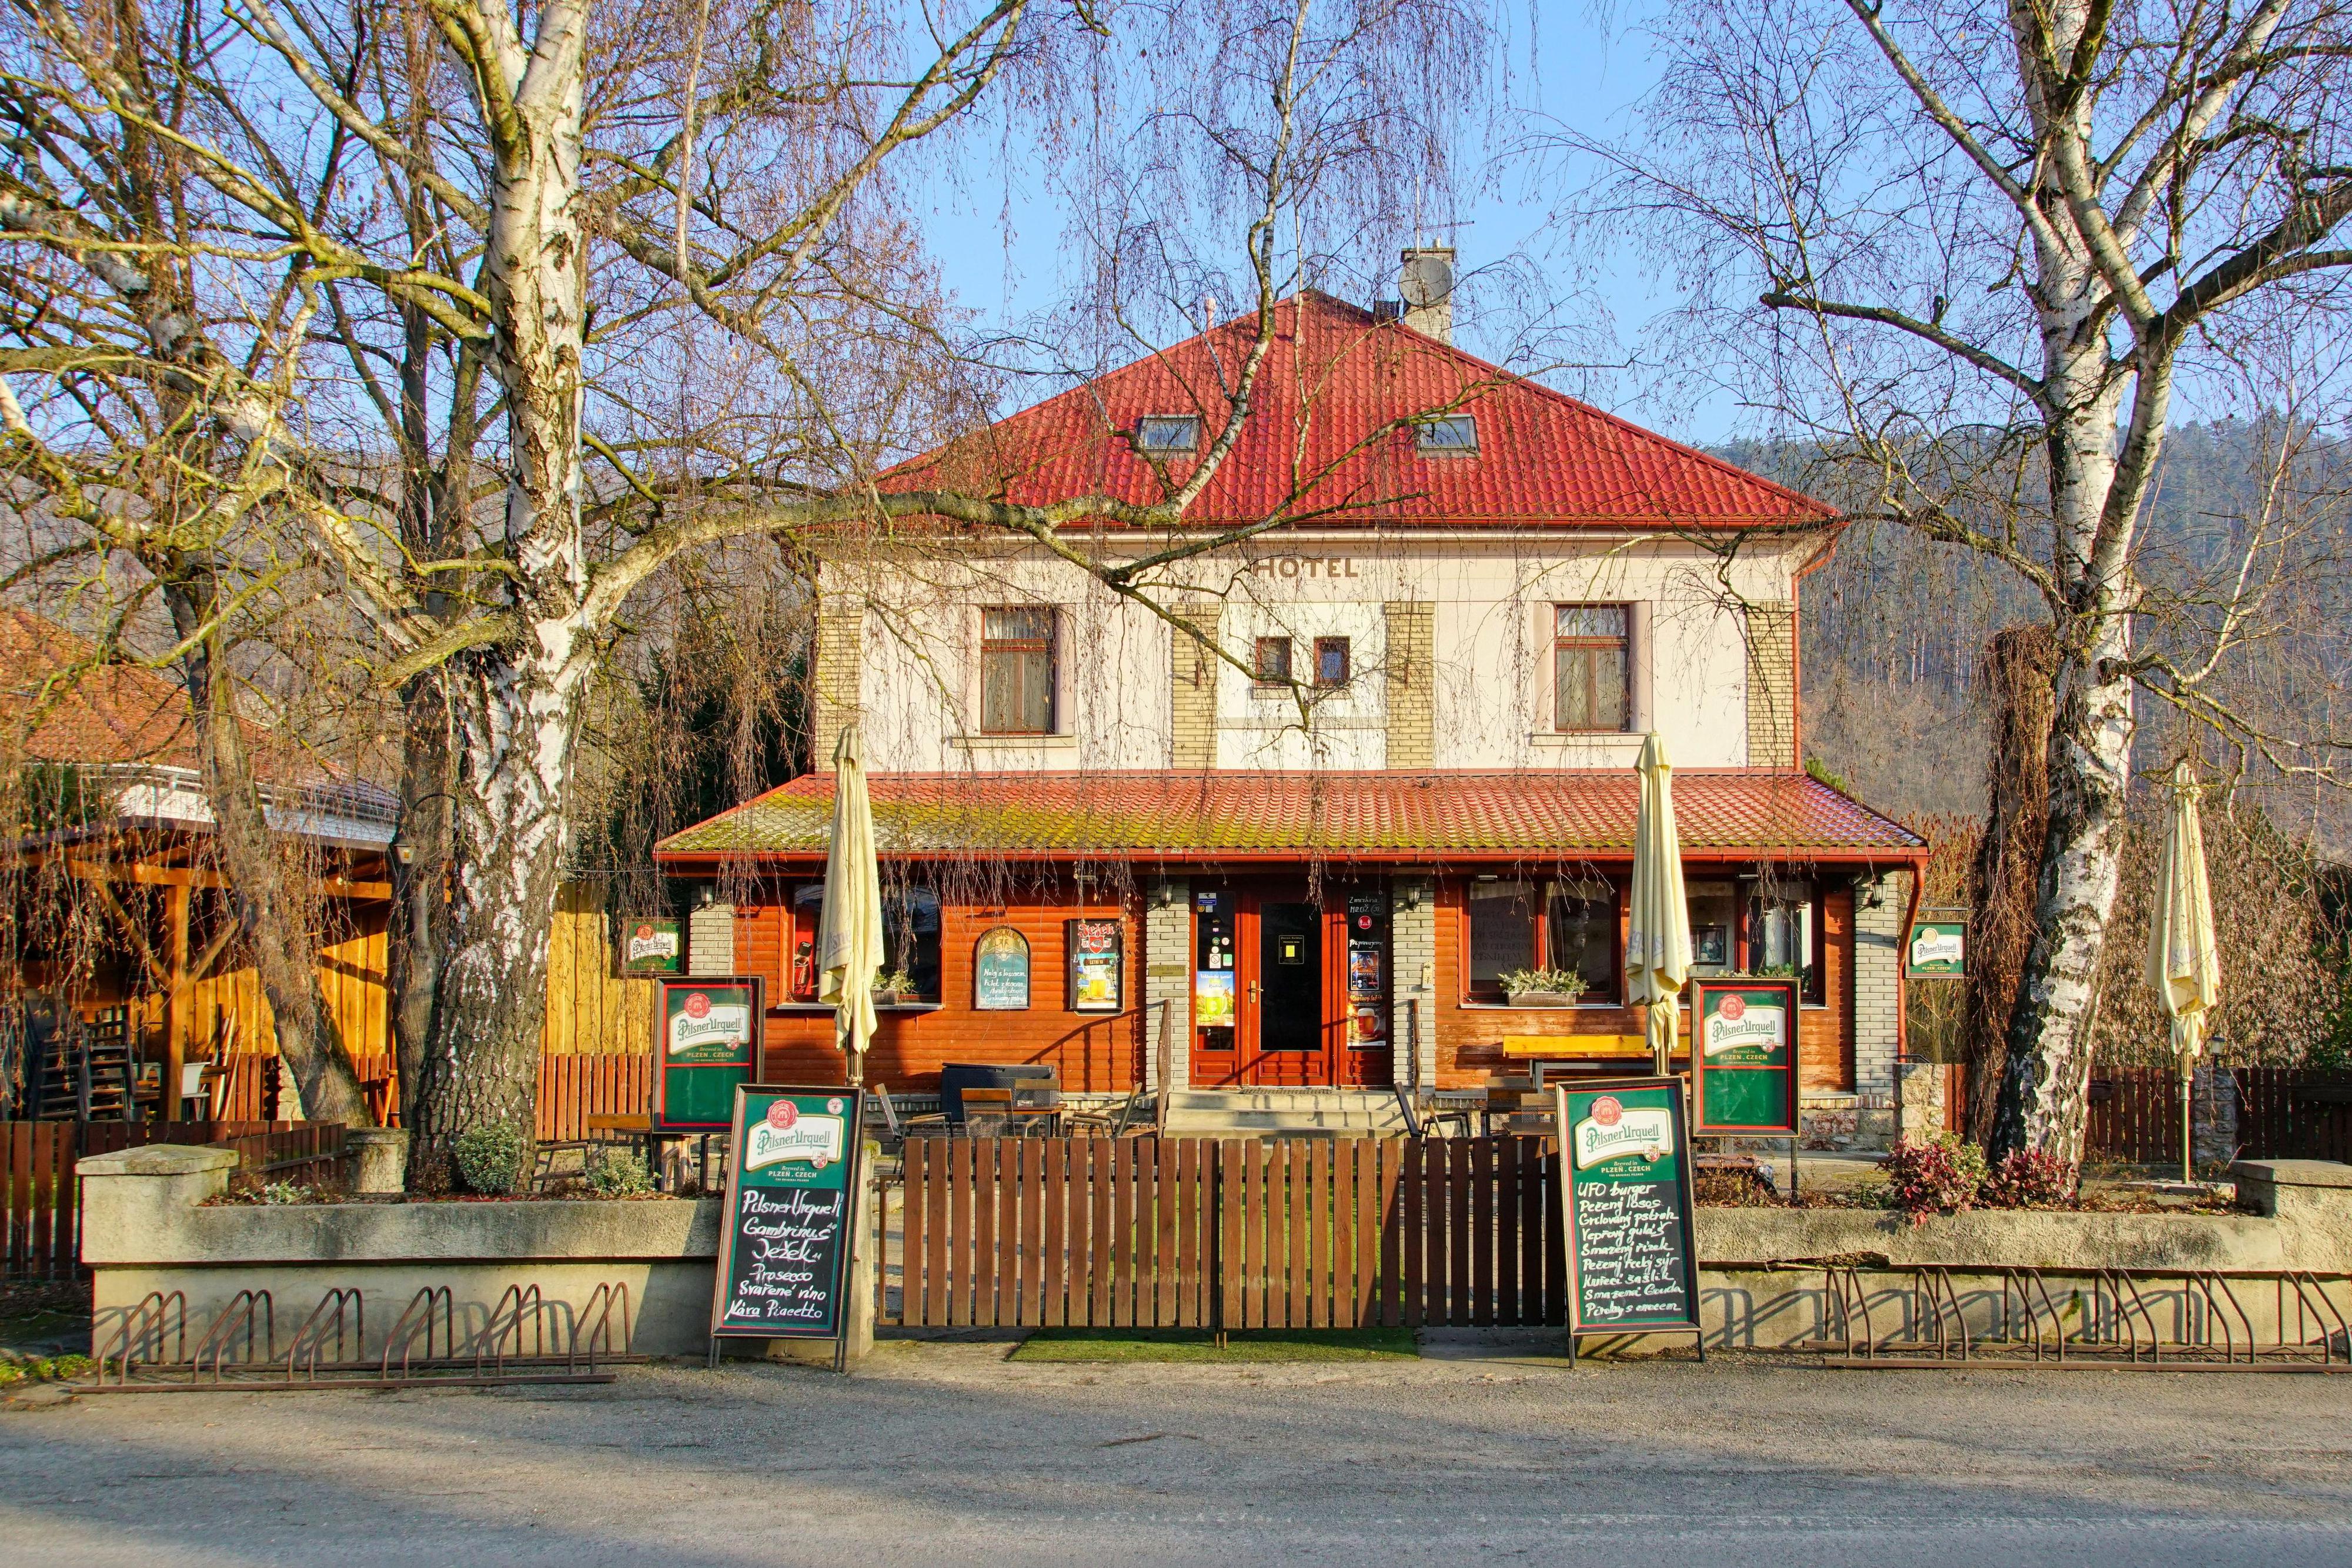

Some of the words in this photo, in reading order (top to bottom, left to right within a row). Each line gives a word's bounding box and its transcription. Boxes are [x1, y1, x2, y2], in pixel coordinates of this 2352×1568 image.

[1253, 558, 1358, 577] HOTEL
[1078, 923, 1115, 938] Ježek
[633, 940, 653, 957] Pilsner
[653, 939, 671, 950] Urquell
[1918, 944, 1937, 958] Pilsner
[1937, 943, 1956, 954] Urquell
[678, 1018, 710, 1041] Pilsner
[710, 1017, 741, 1034] Urquell
[1712, 1020, 1745, 1043] Pilsner
[1745, 1019, 1775, 1036] Urquell
[757, 1129, 795, 1155] Pilsner
[795, 1129, 830, 1149] Urquell
[1586, 1127, 1623, 1153] Pilsner
[1623, 1124, 1659, 1142] Urquell
[1578, 1182, 1606, 1198] UFO
[1609, 1181, 1657, 1203] burger
[742, 1190, 791, 1213] Pilsner
[792, 1189, 844, 1227] Urquell
[1579, 1196, 1623, 1216] Pečený
[1626, 1194, 1662, 1209] losos
[1633, 1206, 1679, 1227] pstruh
[743, 1216, 831, 1241] Gambrinus
[1626, 1221, 1672, 1244] guláš
[752, 1238, 816, 1262] Ježek
[749, 1263, 813, 1282] Prosecco
[1582, 1256, 1623, 1278] Pečený
[1655, 1252, 1679, 1273] sýr
[739, 1281, 796, 1297] Svařené
[798, 1285, 826, 1301] víno
[1643, 1281, 1685, 1296] Gouda
[766, 1299, 823, 1318] Piacetto
